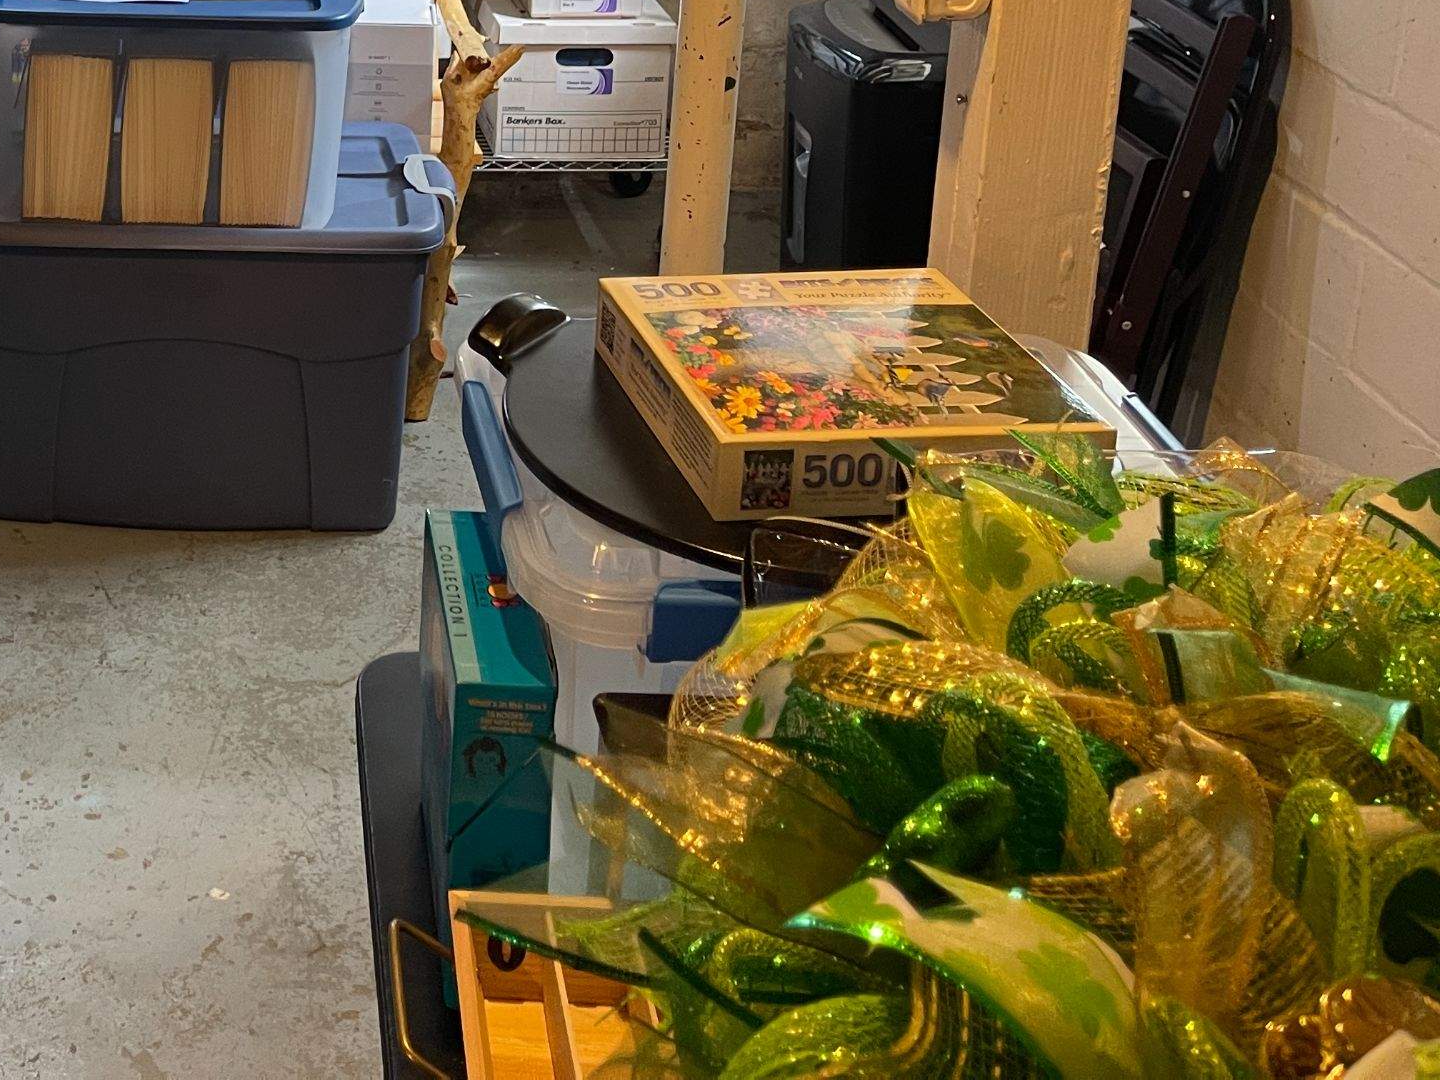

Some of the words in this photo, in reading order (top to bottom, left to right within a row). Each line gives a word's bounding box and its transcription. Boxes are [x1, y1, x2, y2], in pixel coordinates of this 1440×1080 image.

[506, 116, 543, 126] Bankers
[630, 281, 722, 300] 500
[802, 453, 883, 488] 500
[439, 545, 464, 626] COLLECTION
